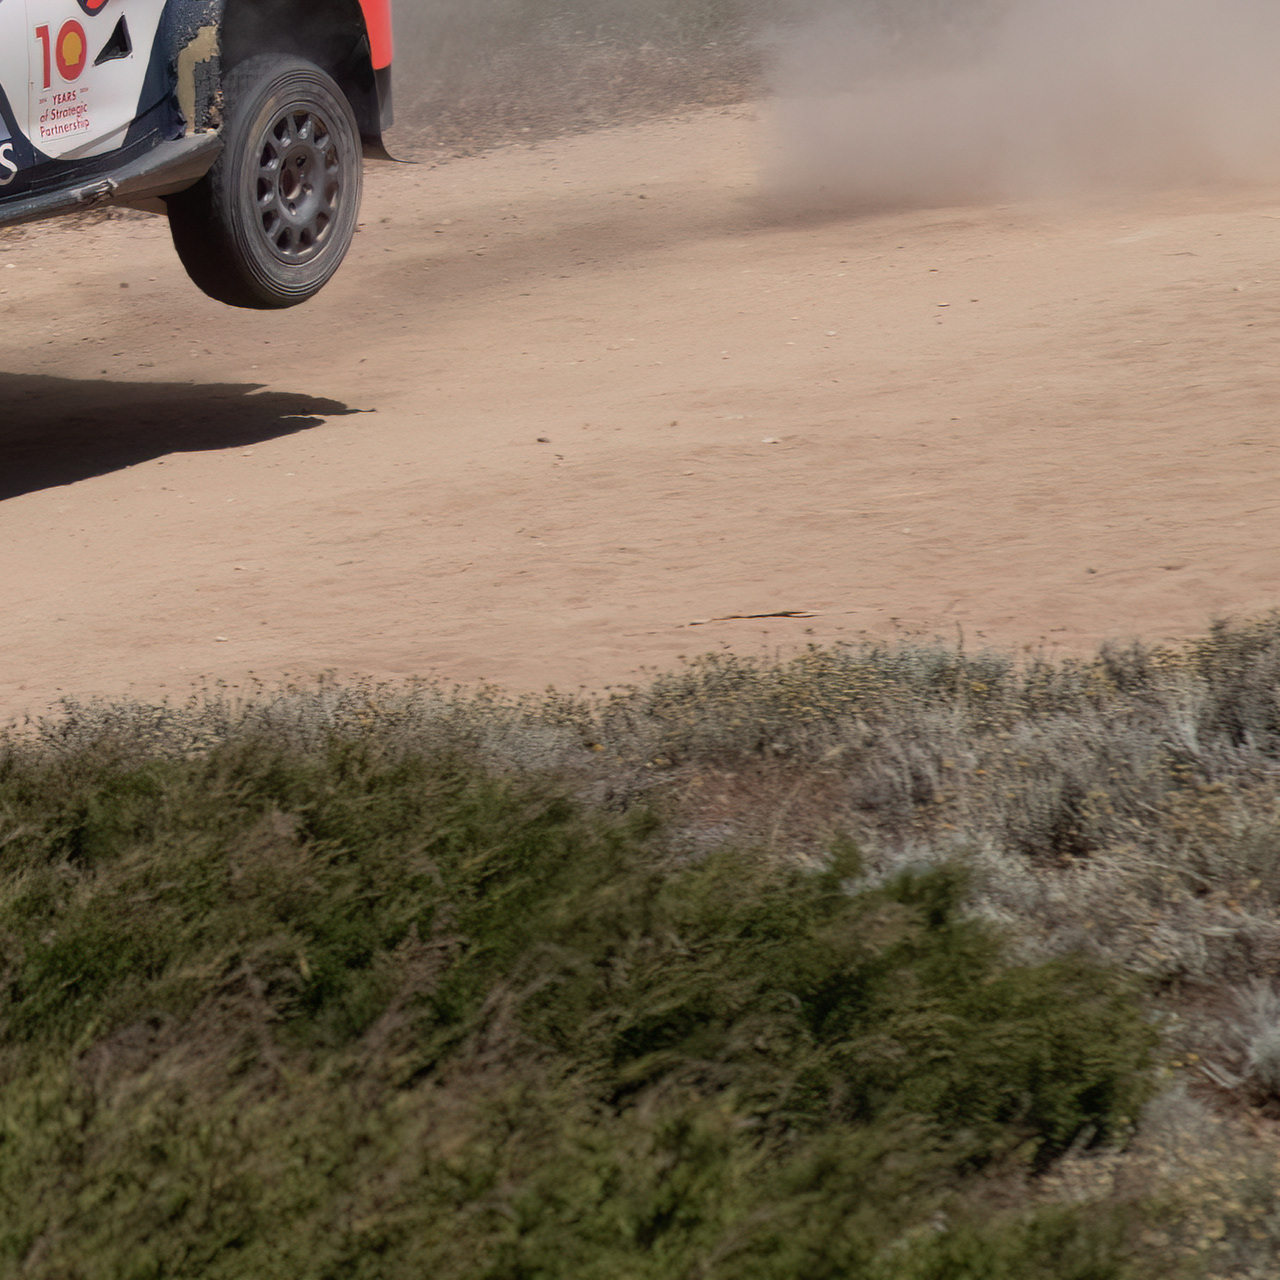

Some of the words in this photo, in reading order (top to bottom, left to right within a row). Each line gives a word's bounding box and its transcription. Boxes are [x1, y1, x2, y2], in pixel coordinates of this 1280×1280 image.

[35, 19, 87, 89] 10
[53, 90, 77, 105] YEARS
[40, 112, 50, 123] of
[51, 101, 88, 121] Strategic
[40, 118, 90, 138] Partnership
